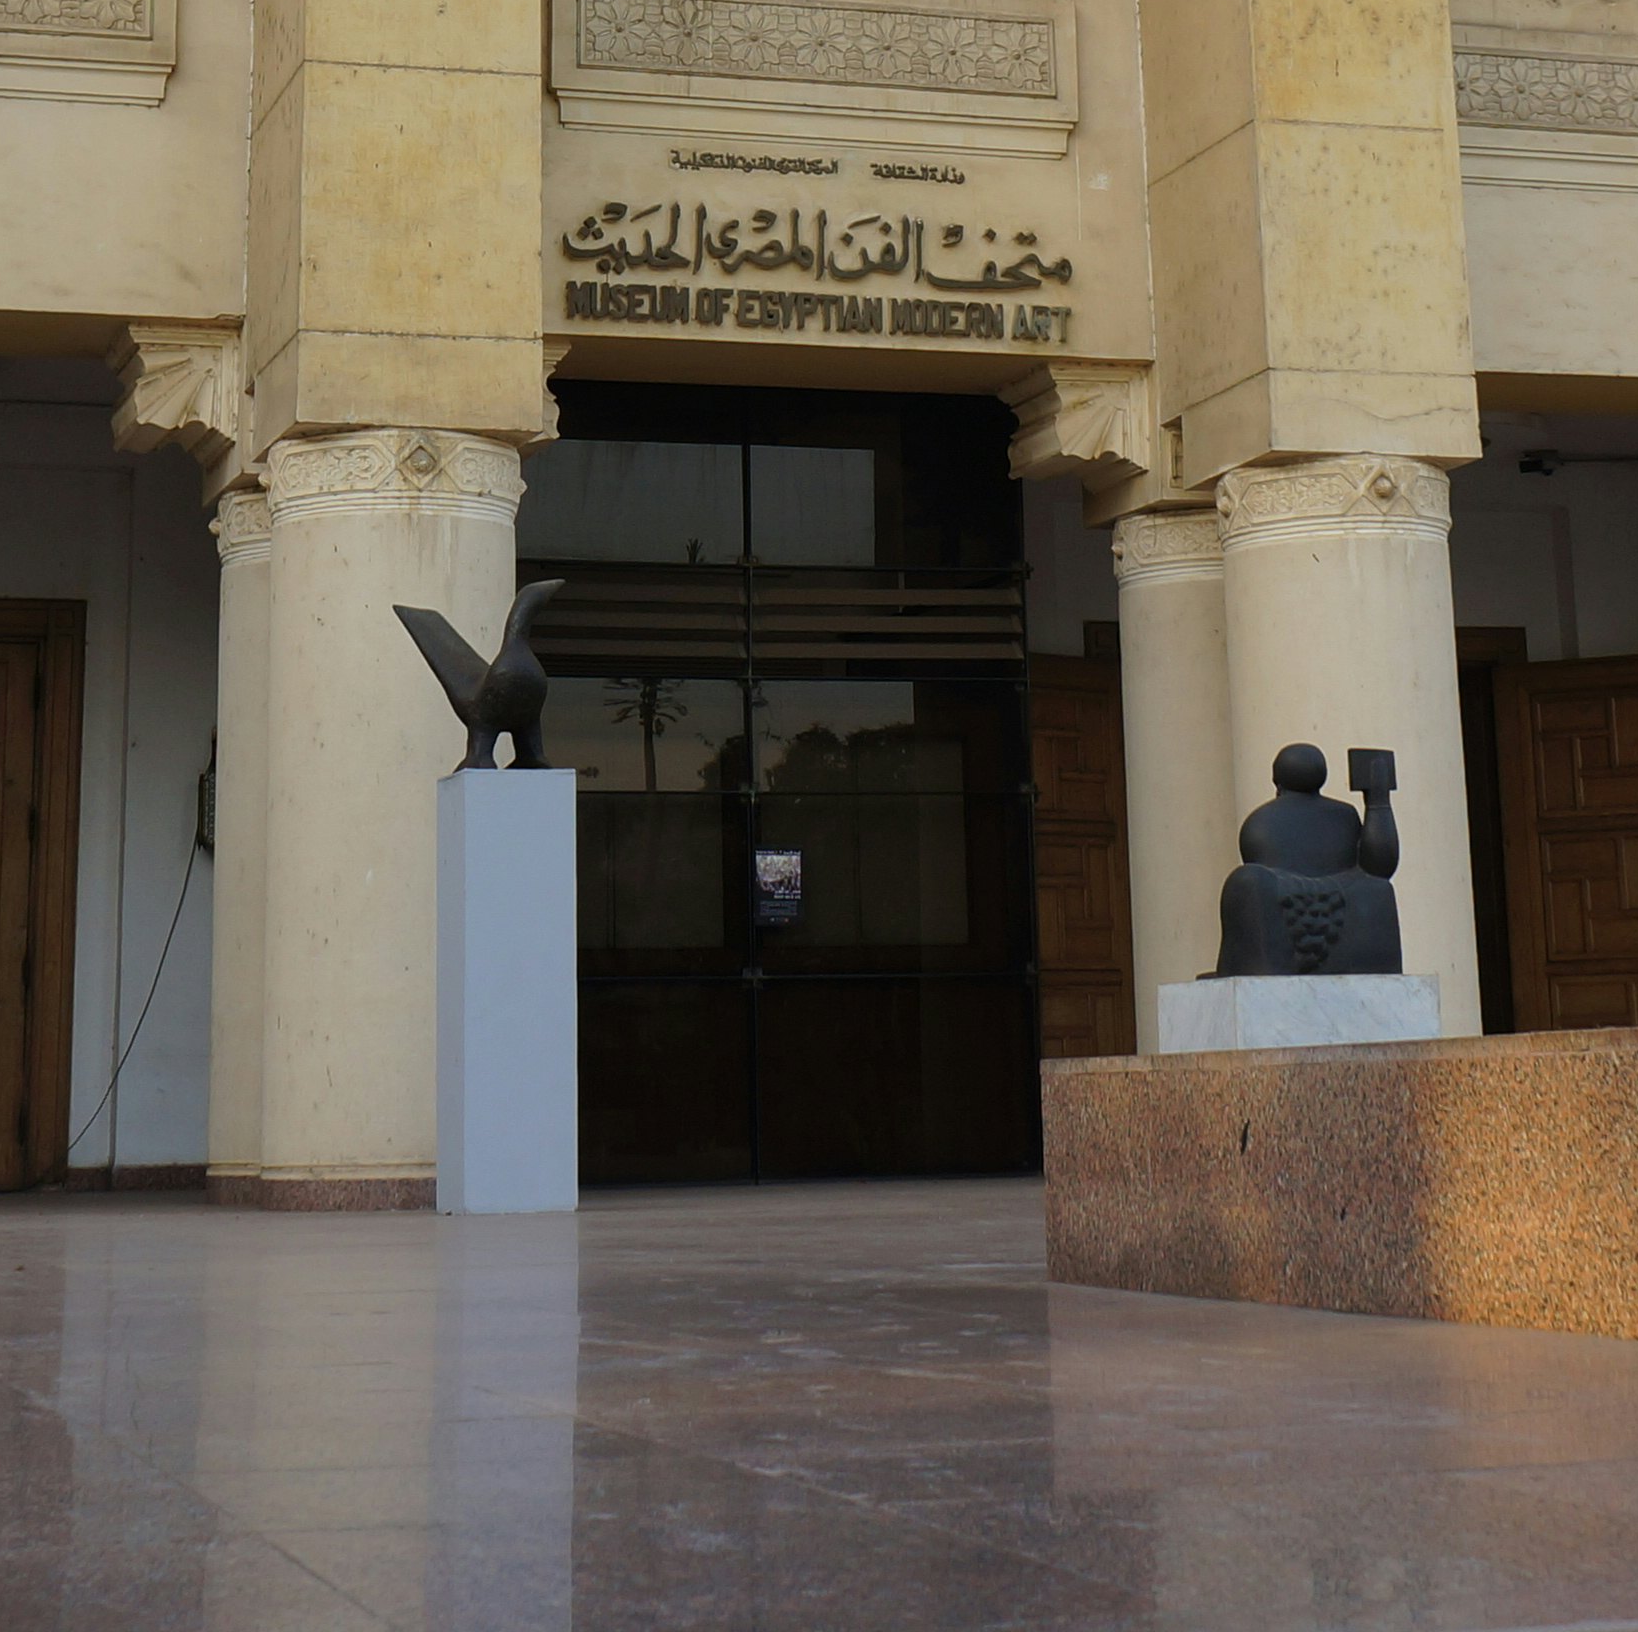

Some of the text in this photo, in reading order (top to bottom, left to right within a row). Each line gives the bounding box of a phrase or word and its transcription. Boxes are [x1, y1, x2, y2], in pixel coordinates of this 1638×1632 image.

[870, 163, 929, 181] الثقافة
[565, 280, 1072, 343] MUSEUM OF EGYPTIAN MODERN ART
